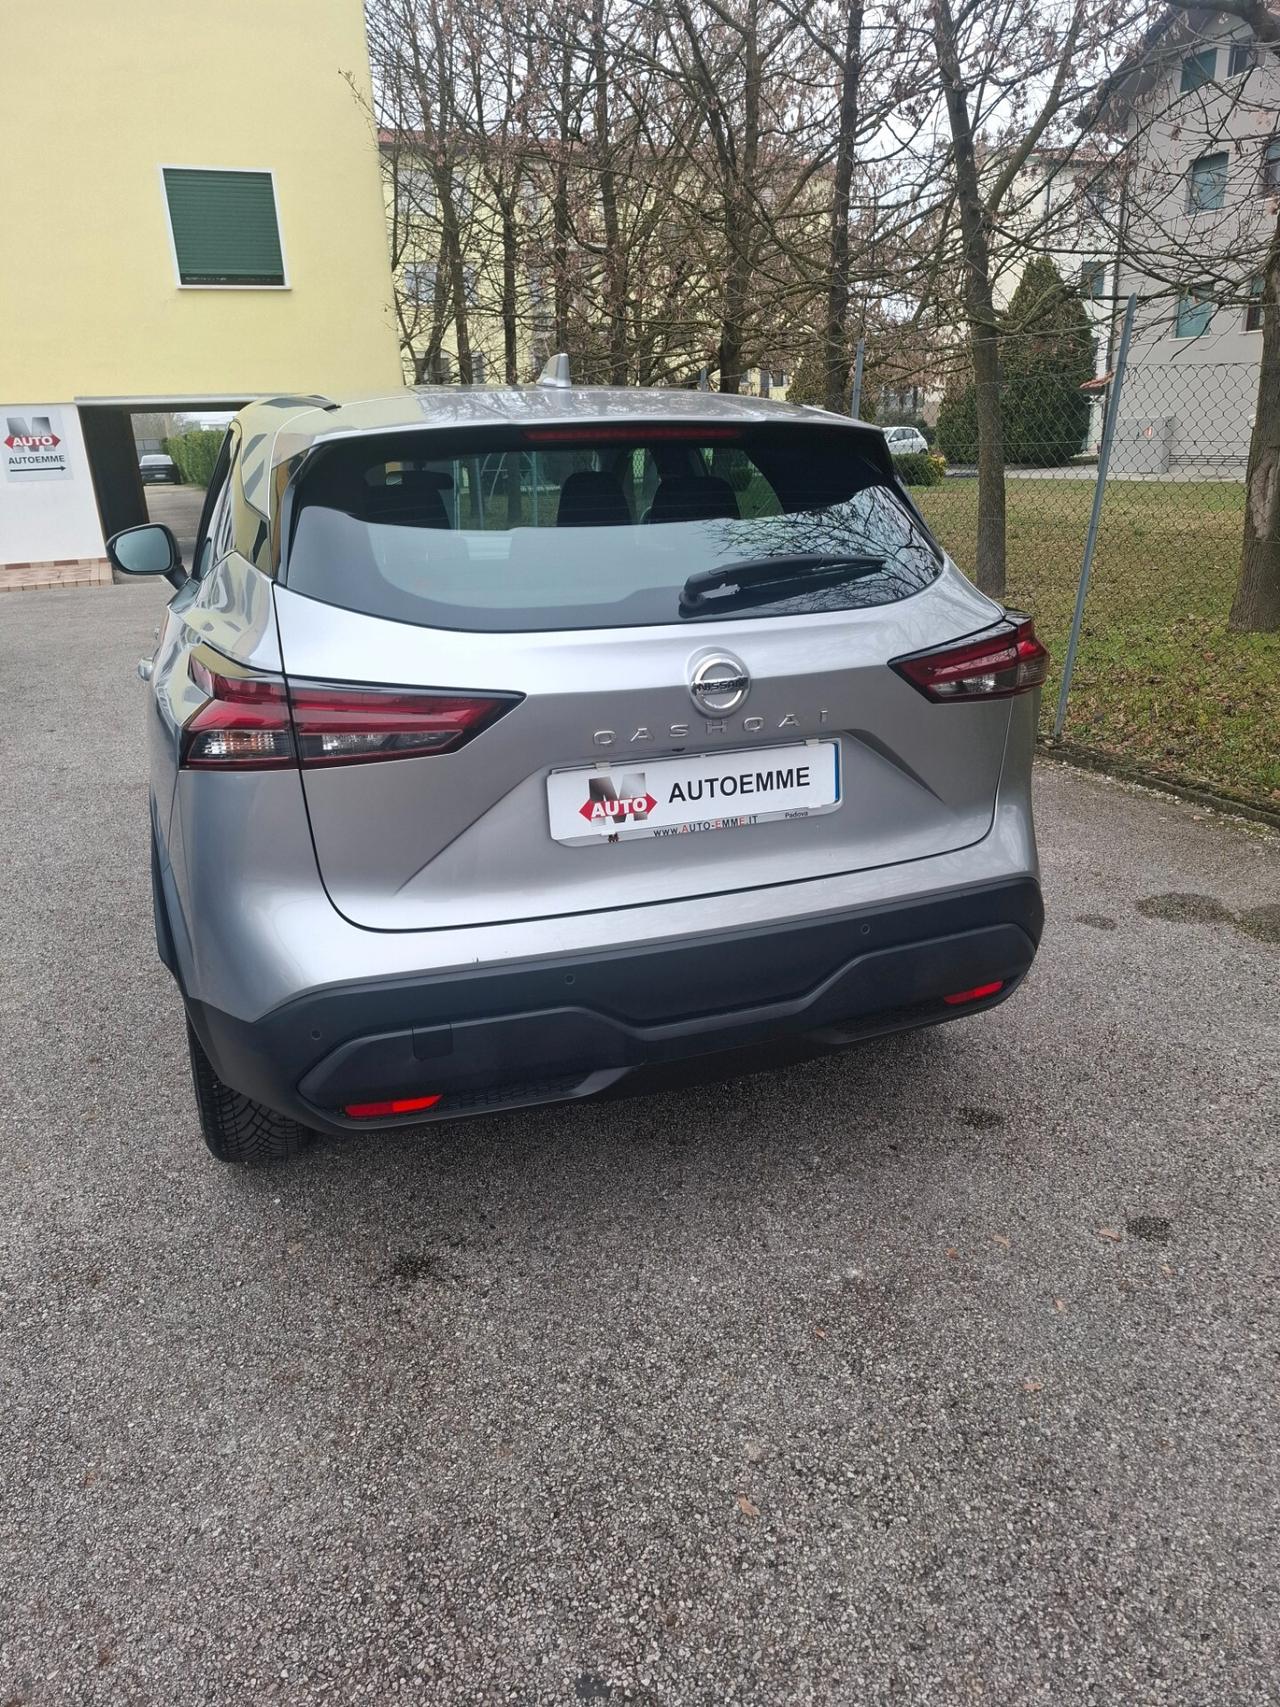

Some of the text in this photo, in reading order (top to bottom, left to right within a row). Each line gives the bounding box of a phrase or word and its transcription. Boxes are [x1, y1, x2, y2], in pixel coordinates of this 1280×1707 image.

[13, 436, 53, 447] AUTO
[9, 455, 65, 464] AUTOEMME
[699, 677, 746, 692] NISSAN
[593, 710, 829, 744] QASHQAI
[669, 767, 810, 803] AUTOEMME
[591, 797, 648, 818] AUTO
[785, 810, 809, 819] Padova
